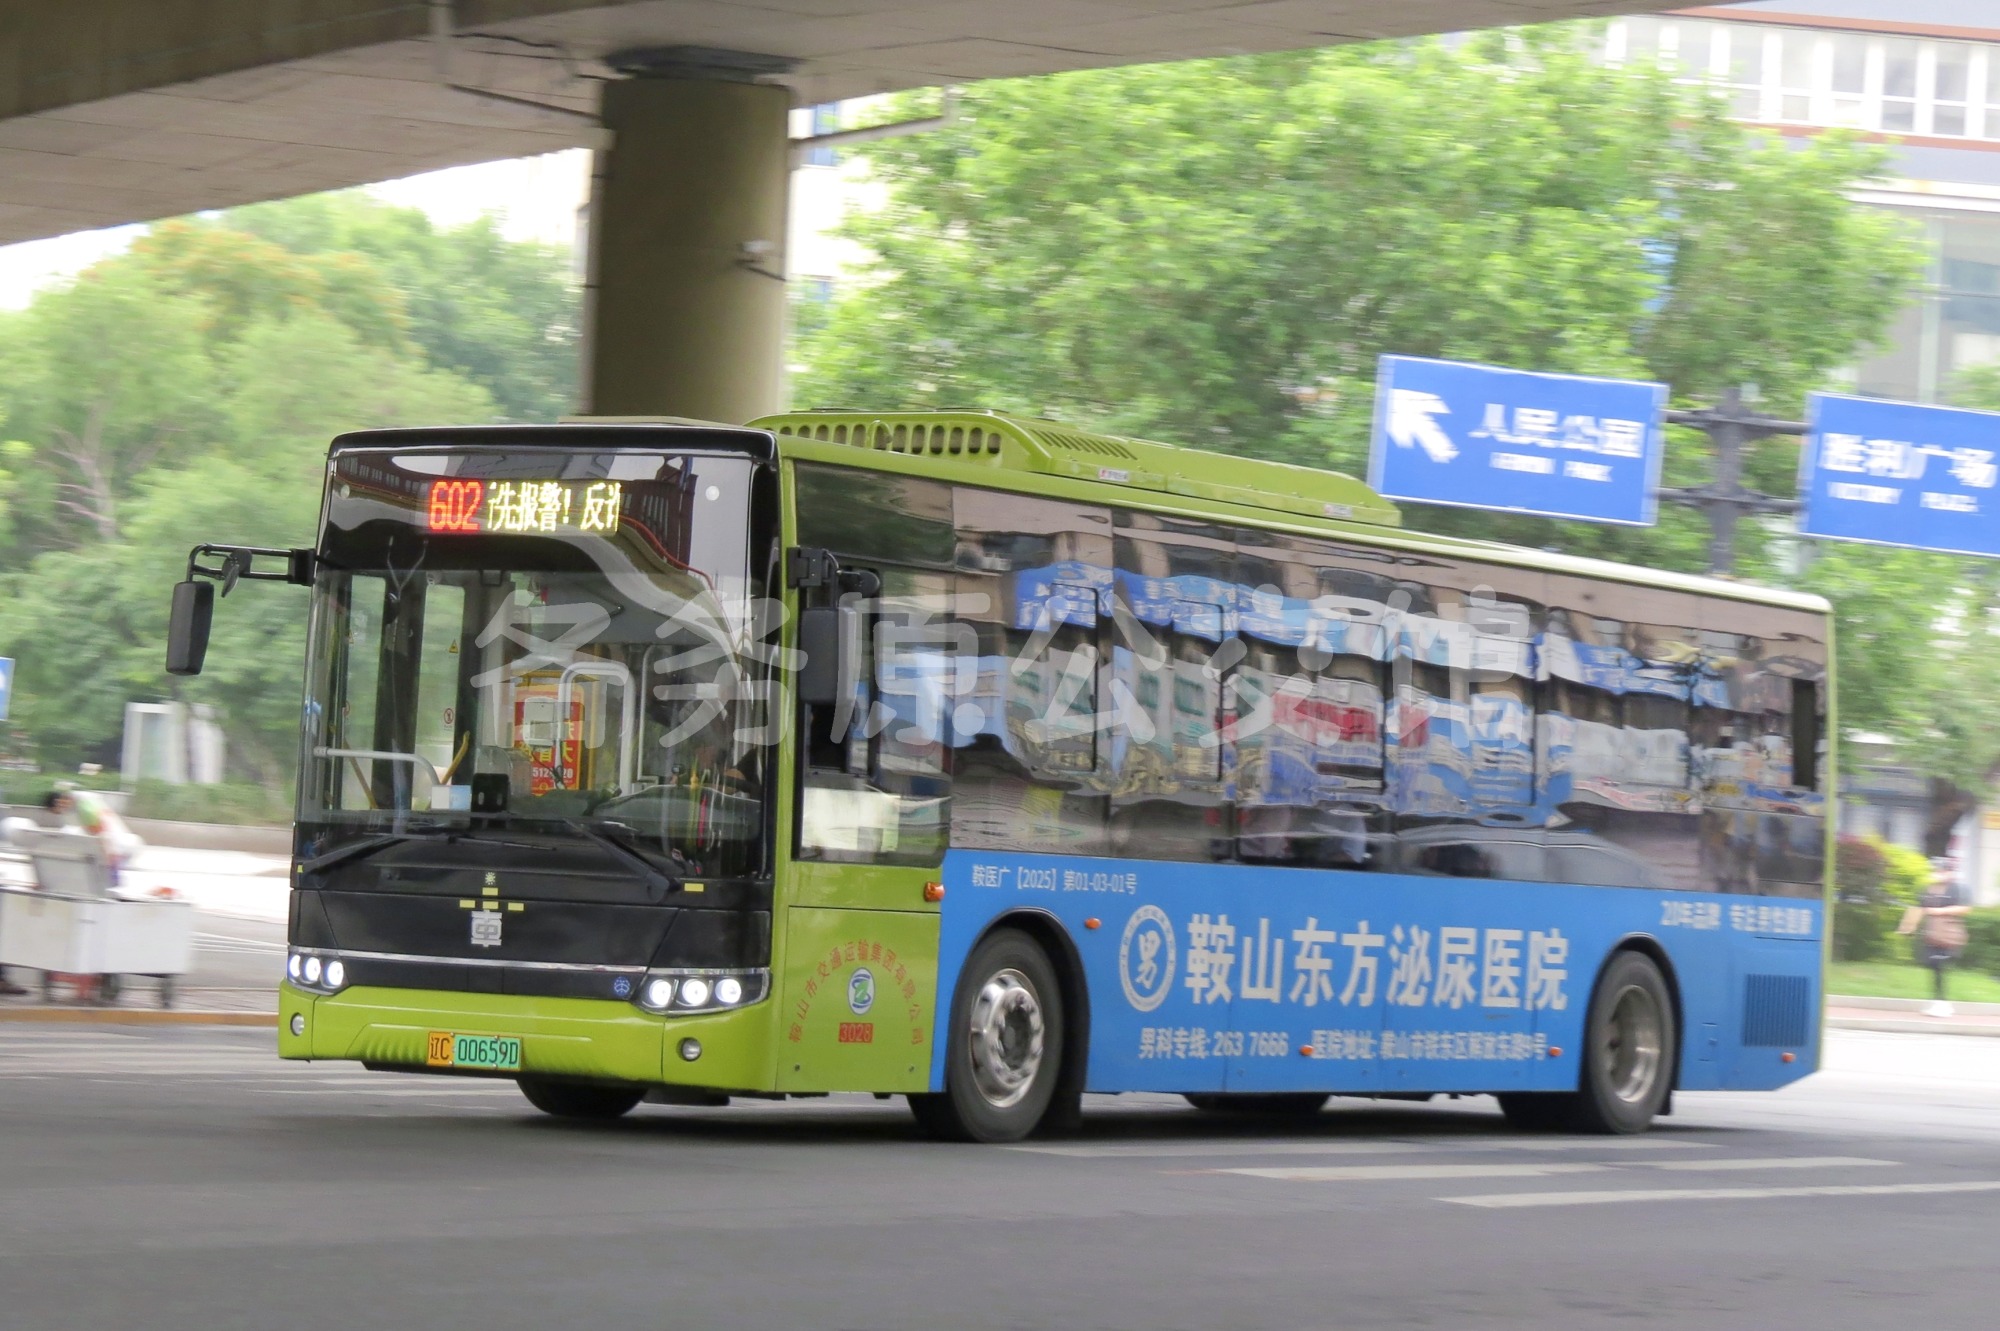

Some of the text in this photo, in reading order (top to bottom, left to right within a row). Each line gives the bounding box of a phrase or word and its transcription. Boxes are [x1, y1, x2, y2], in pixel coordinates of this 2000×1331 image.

[1467, 403, 1646, 459] 人民公园
[1817, 432, 1999, 488] 胜利广场
[428, 480, 483, 532] 602
[1184, 913, 1569, 1012] 鞍山东方泌尿医院
[839, 1023, 874, 1042] 3028
[1249, 1031, 1289, 1057] 7666
